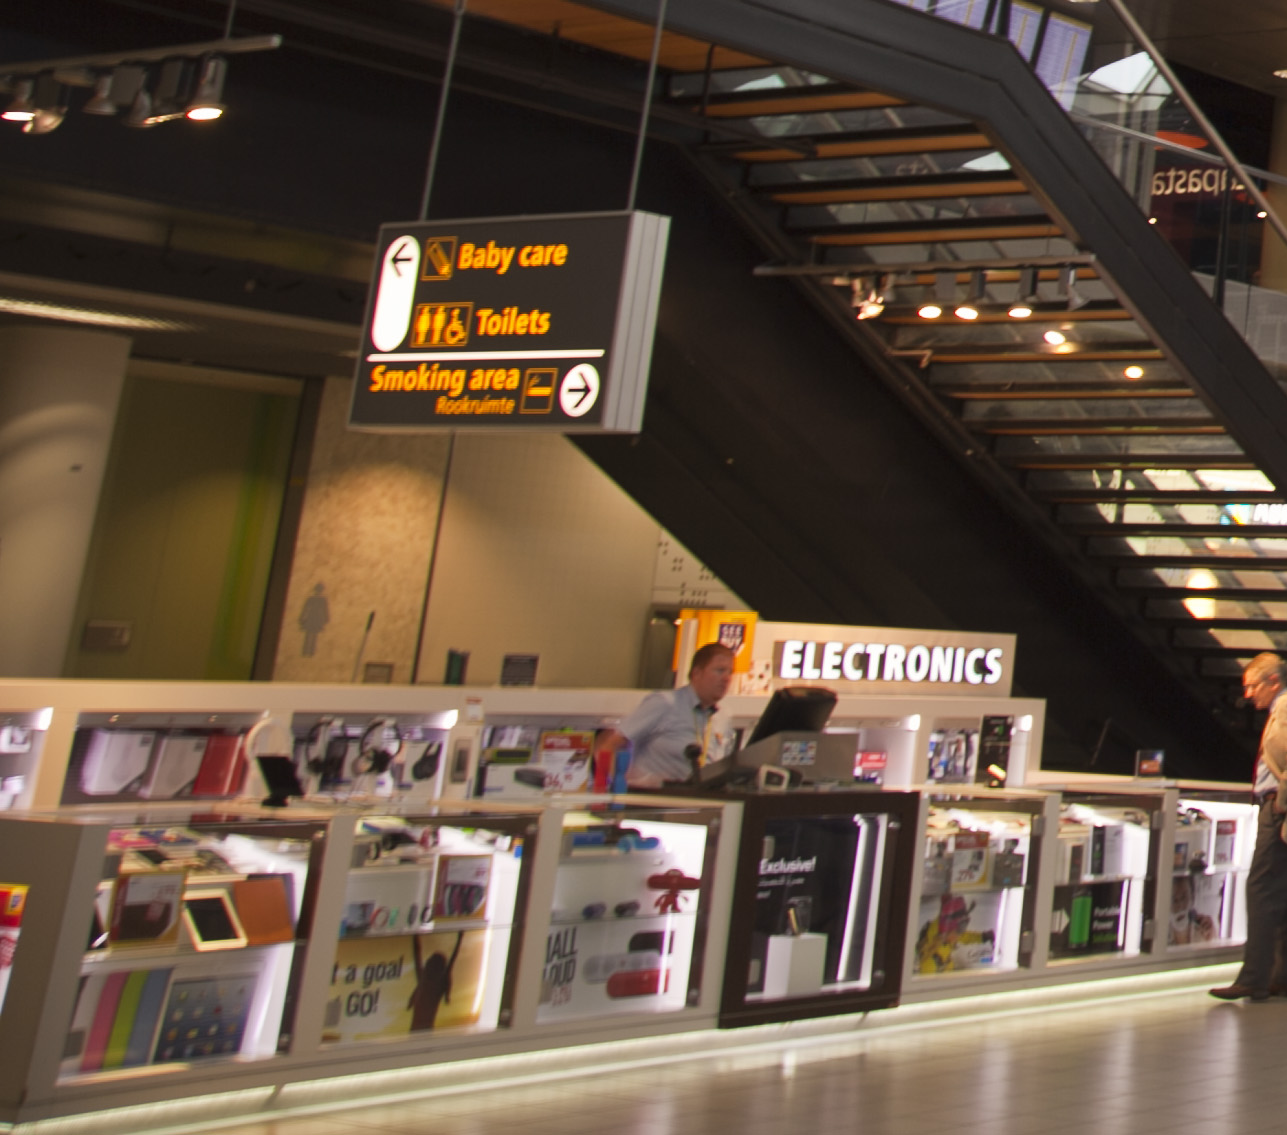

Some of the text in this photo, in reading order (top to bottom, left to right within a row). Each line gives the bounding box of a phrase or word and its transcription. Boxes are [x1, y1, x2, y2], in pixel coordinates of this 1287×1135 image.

[457, 240, 569, 275] Baby care
[475, 306, 551, 336] Toilets
[369, 363, 521, 398] Smoking area
[435, 395, 516, 415] Rookruimte
[779, 640, 1003, 685] ELECTRONICS
[759, 855, 817, 875] Exclusive!
[362, 953, 405, 989] goal
[344, 987, 380, 1018] GO!
